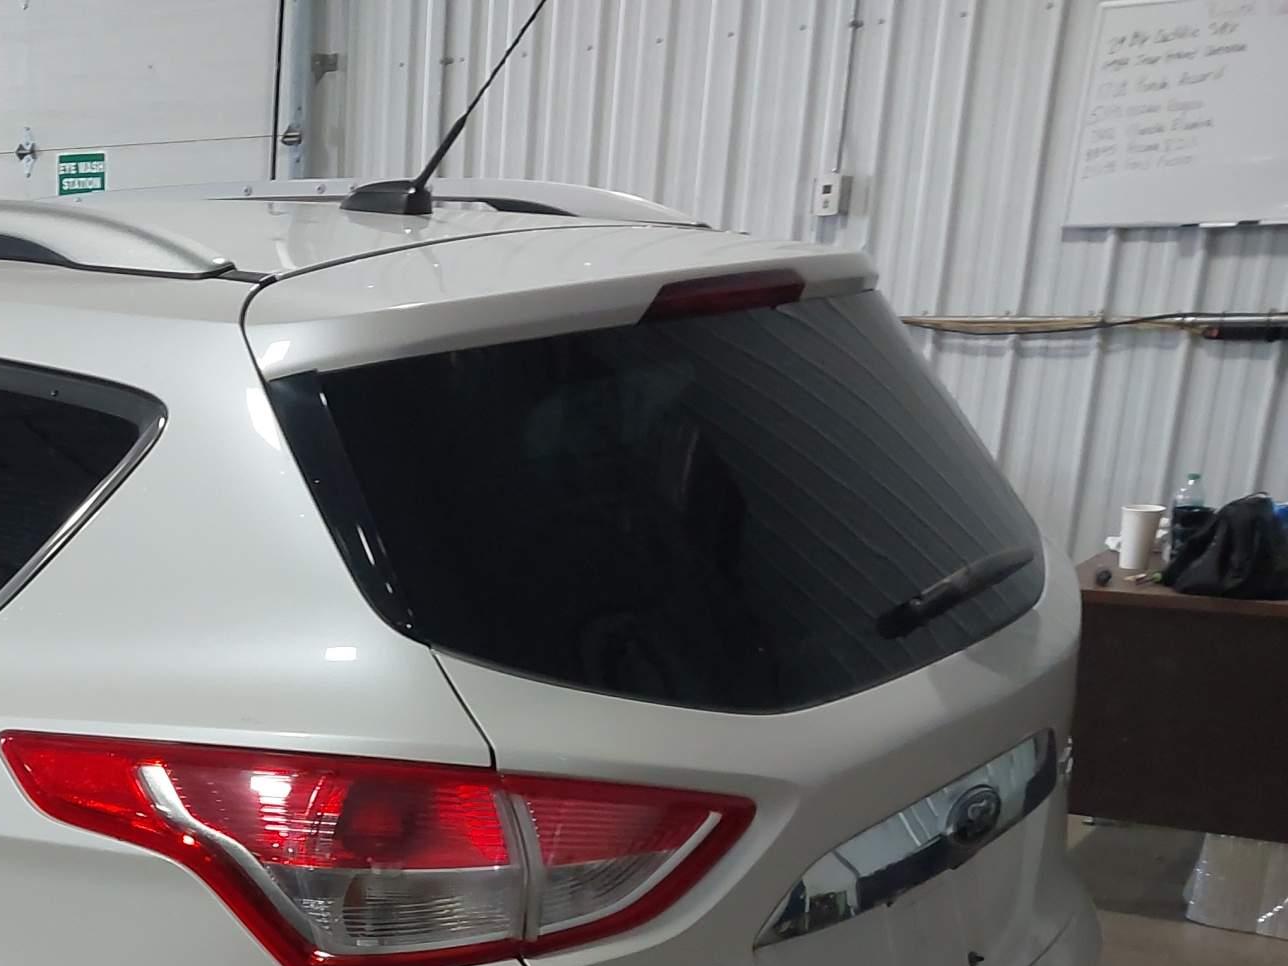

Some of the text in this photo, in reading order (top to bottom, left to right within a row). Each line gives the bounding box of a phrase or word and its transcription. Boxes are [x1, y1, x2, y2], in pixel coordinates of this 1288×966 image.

[58, 161, 105, 174] EYE WASH
[62, 177, 102, 190] STATION
